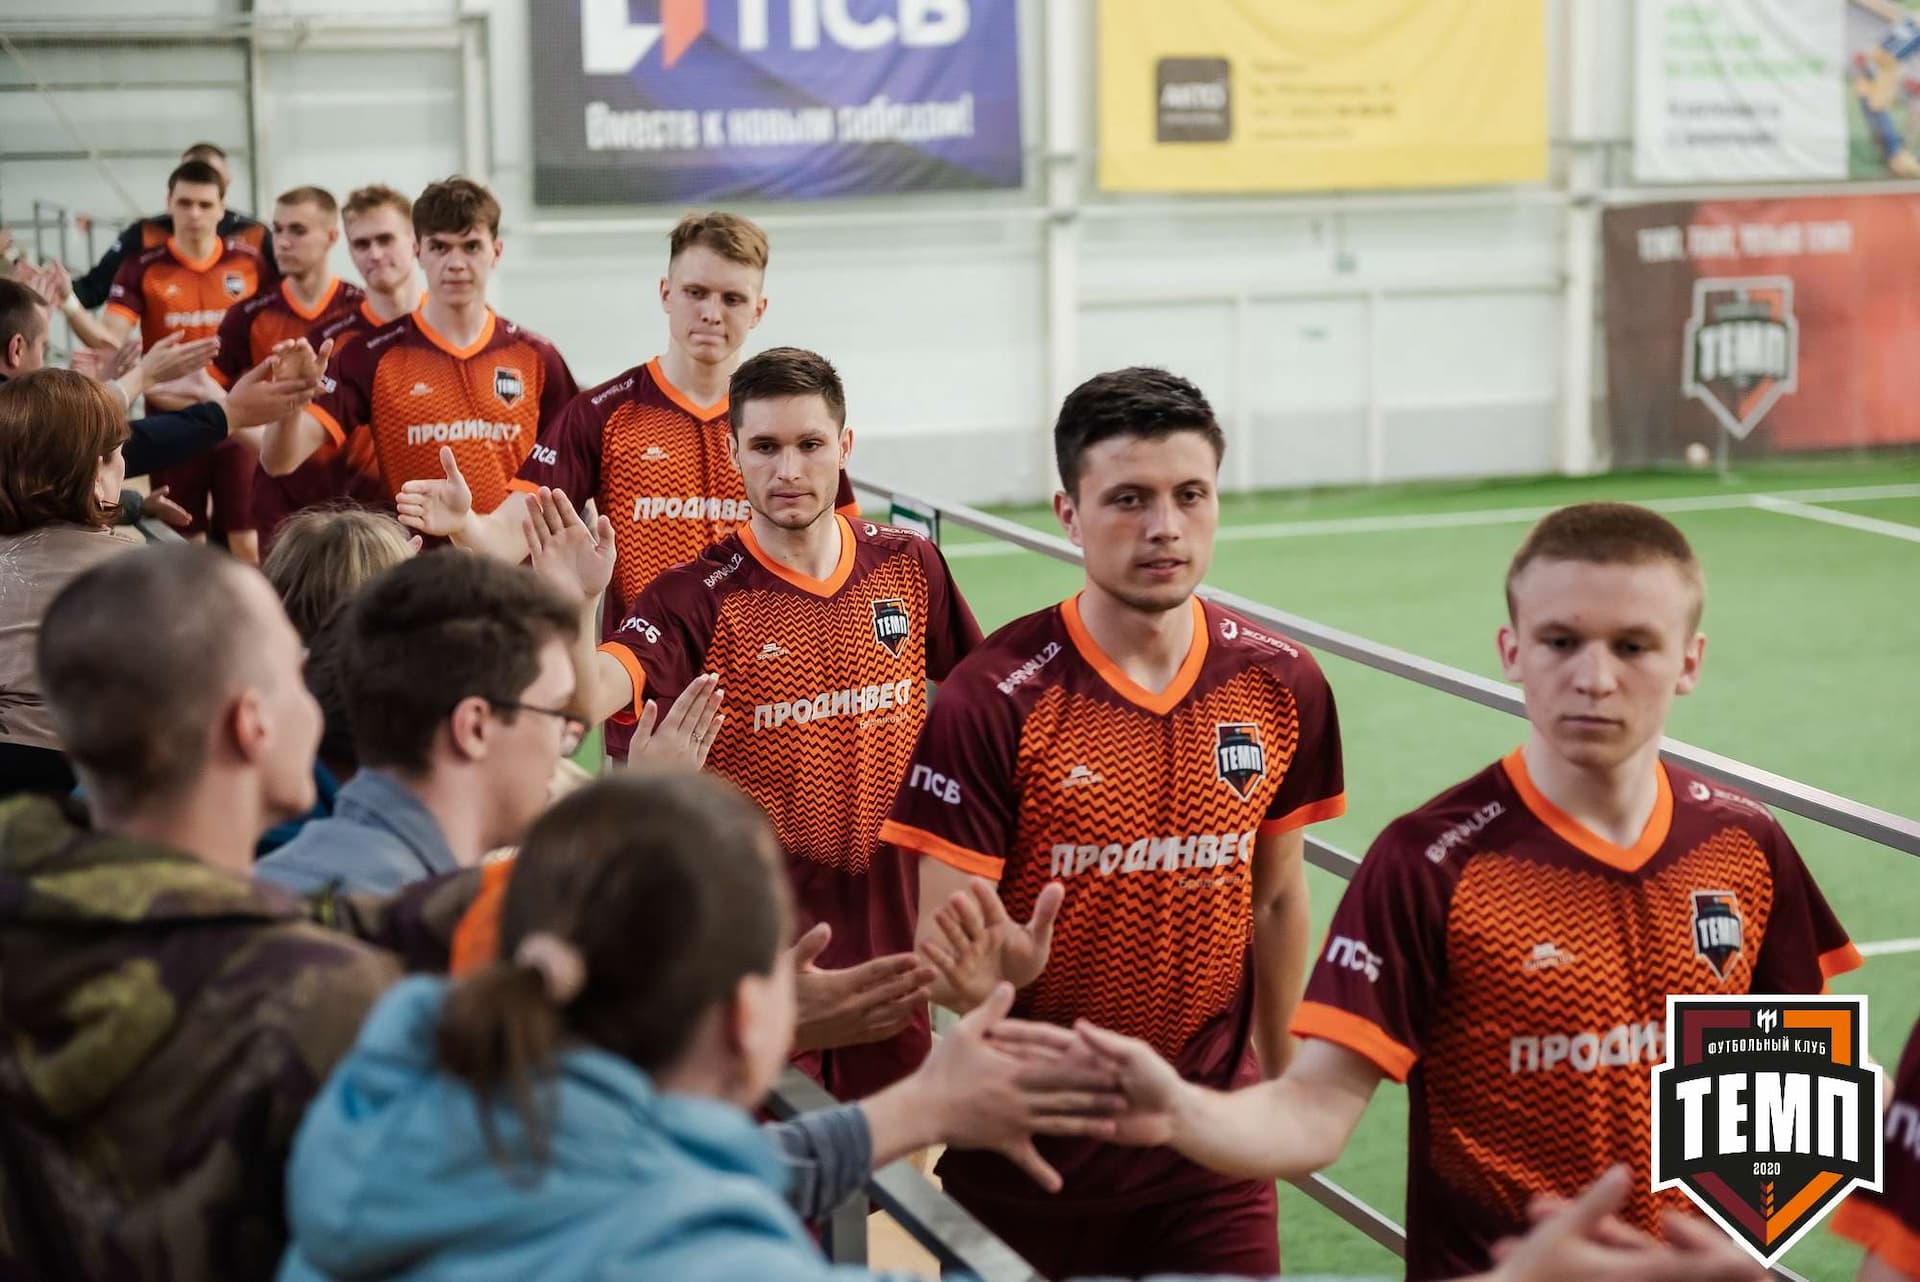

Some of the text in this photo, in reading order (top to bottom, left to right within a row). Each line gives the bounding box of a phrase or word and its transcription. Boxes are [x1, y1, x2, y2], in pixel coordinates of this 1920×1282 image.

[877, 615, 908, 637] ТЕМП
[1220, 745, 1262, 774] ТЕМП
[910, 765, 961, 804] ПСБ
